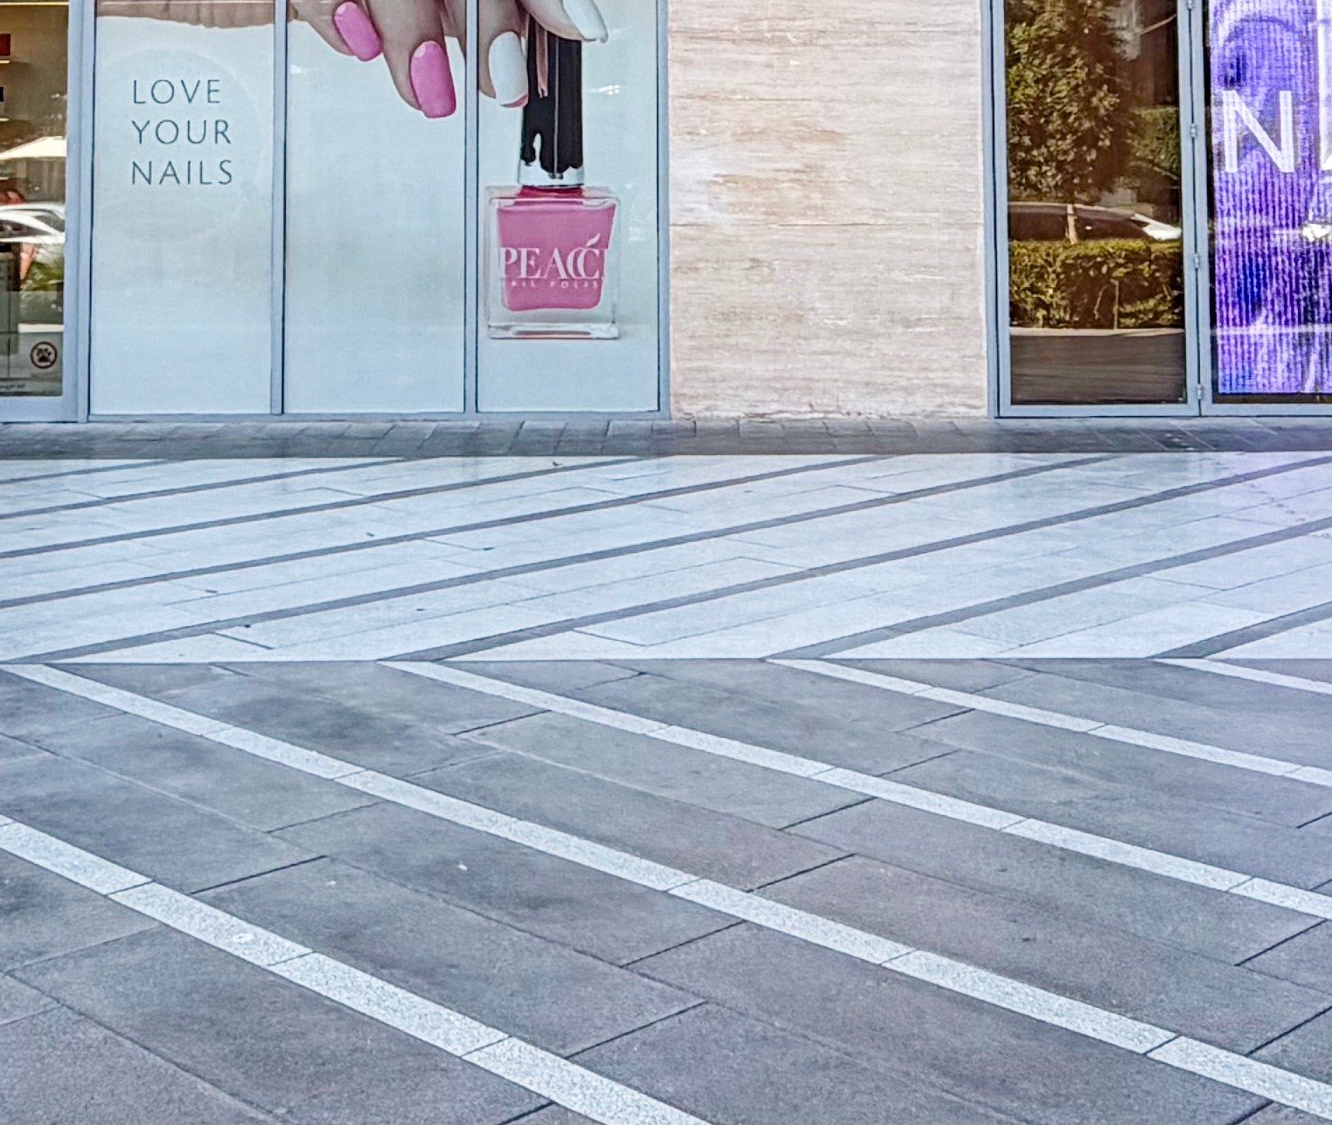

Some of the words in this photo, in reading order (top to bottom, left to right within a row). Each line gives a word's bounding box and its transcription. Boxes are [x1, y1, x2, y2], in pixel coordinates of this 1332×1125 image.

[132, 79, 221, 105] LOVE
[131, 119, 232, 145] YOUR
[131, 159, 233, 185] NAILS
